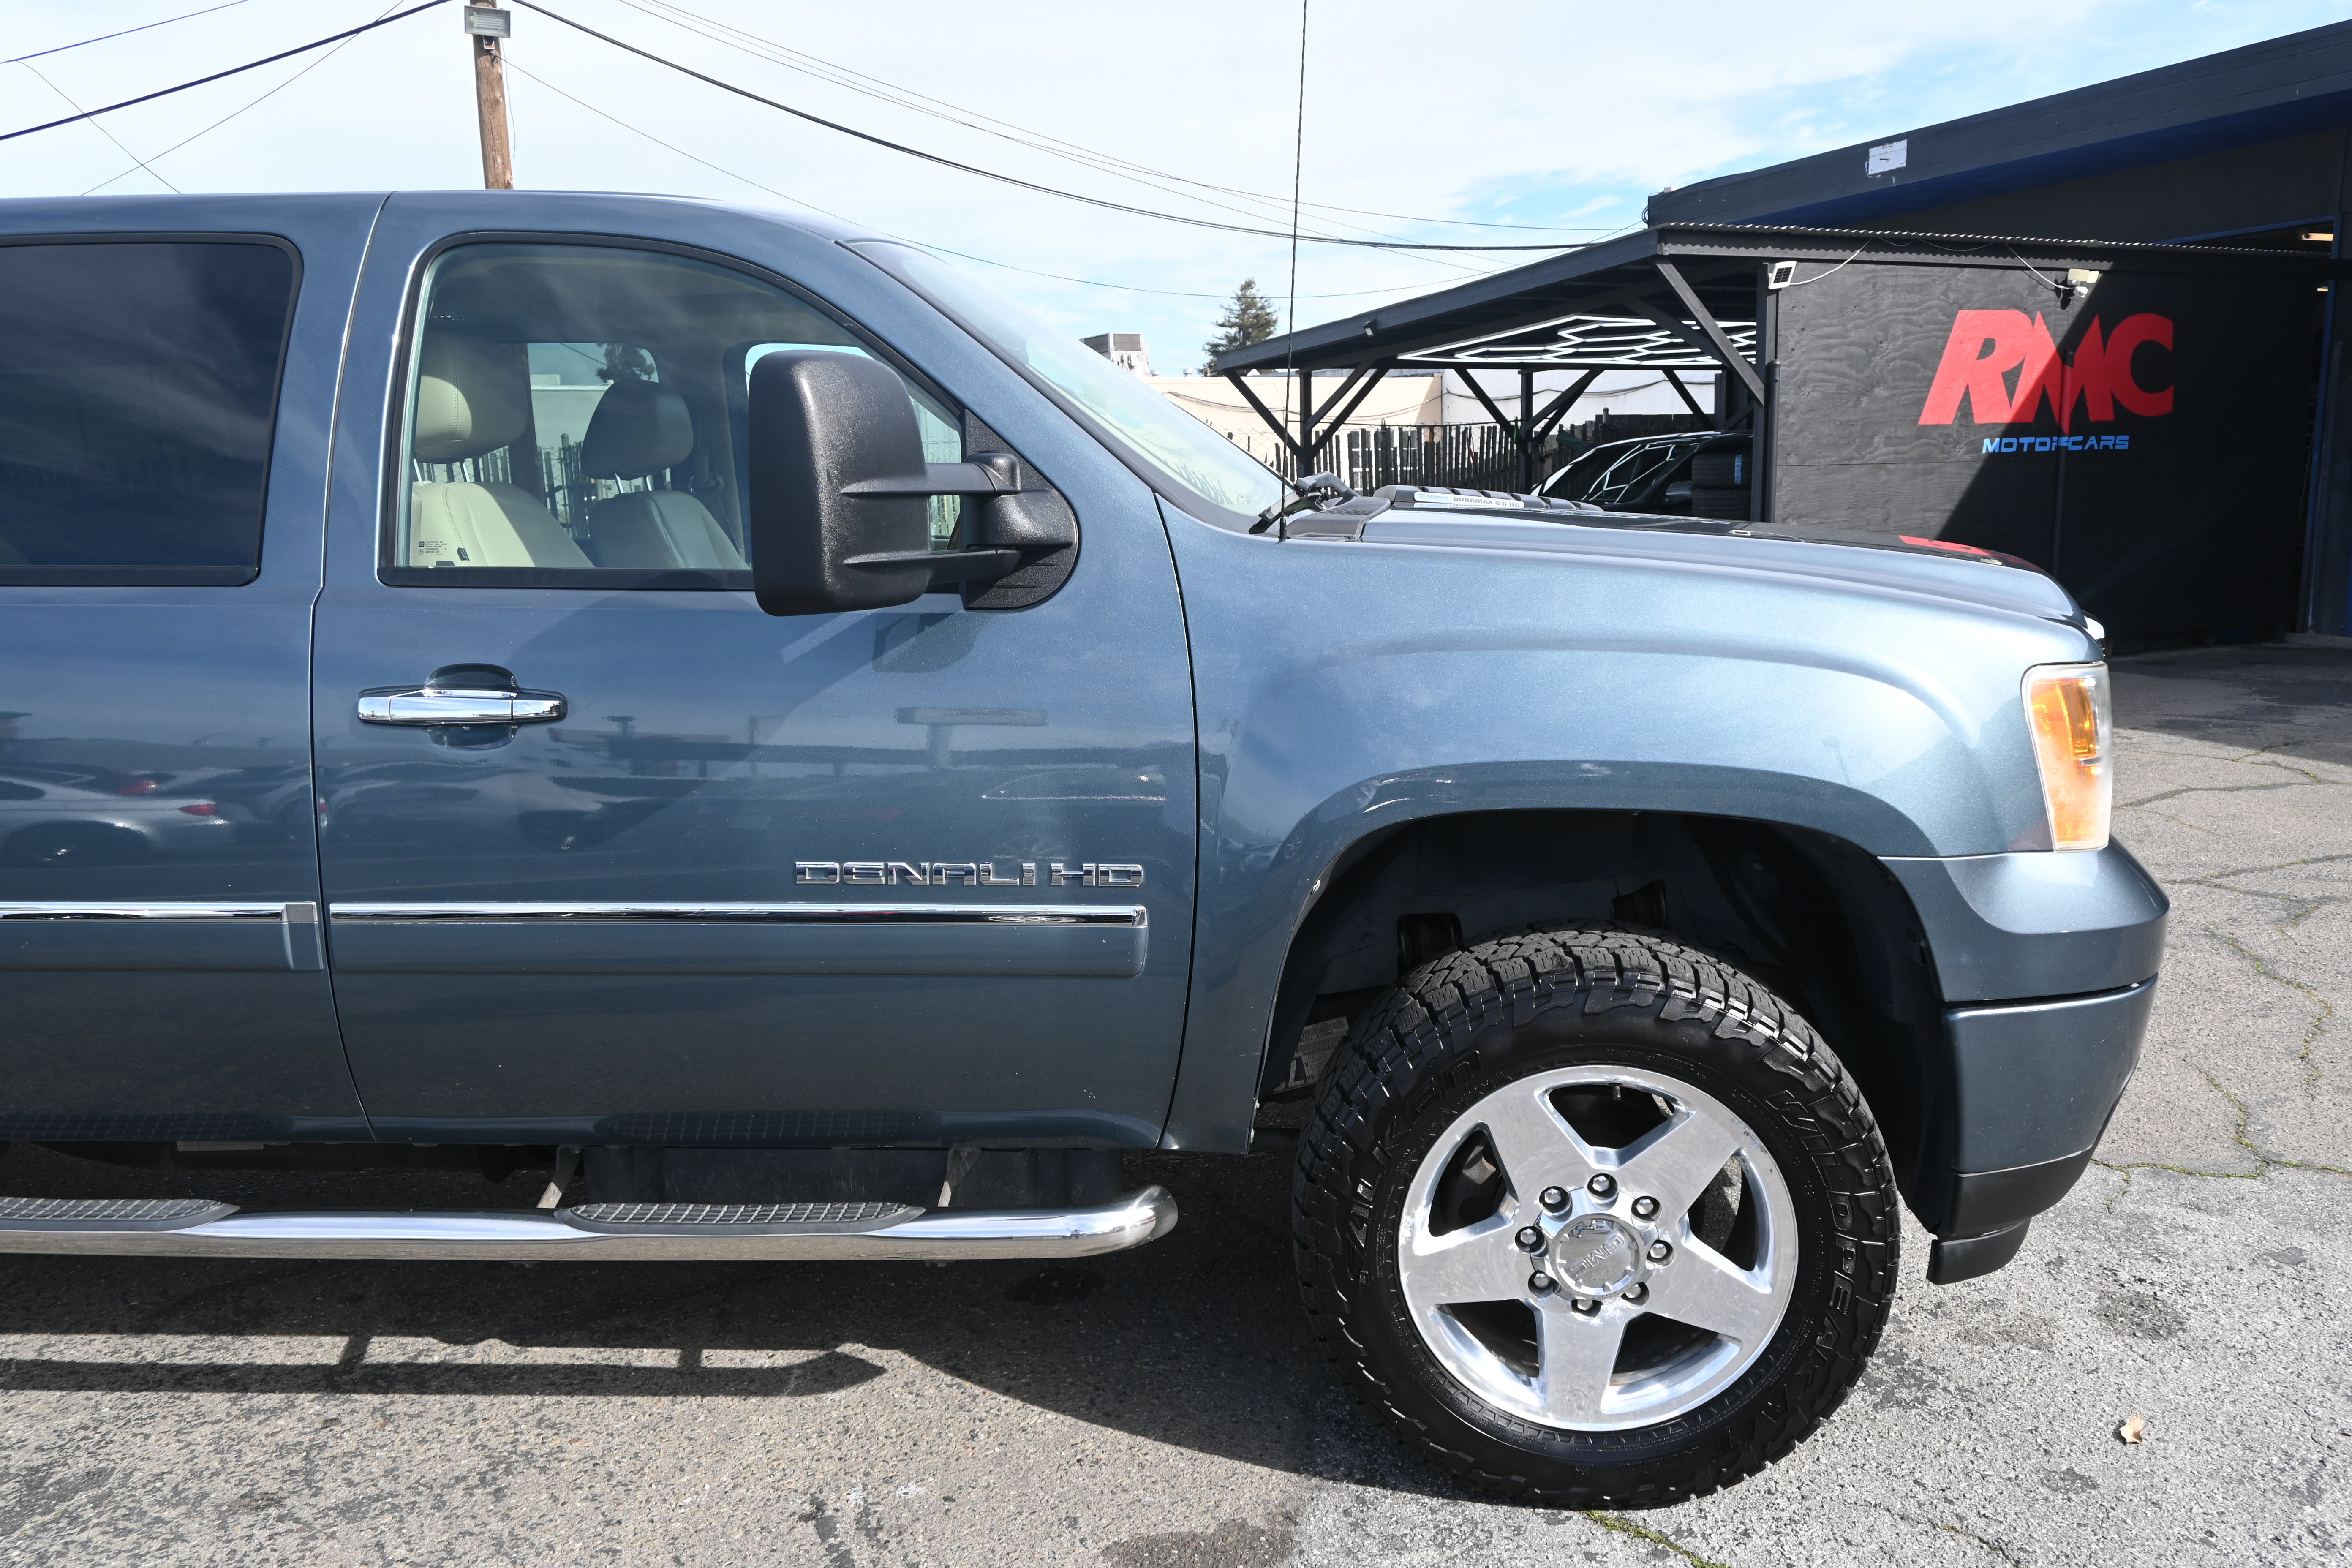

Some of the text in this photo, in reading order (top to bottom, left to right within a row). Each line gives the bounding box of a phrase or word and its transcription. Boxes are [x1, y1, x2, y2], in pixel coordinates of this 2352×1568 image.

[1918, 309, 2174, 435] RMC
[795, 861, 1143, 887] DENALI HD
[1569, 1232, 1625, 1277] GMC
[1764, 1089, 1858, 1392] WILDPEAK
